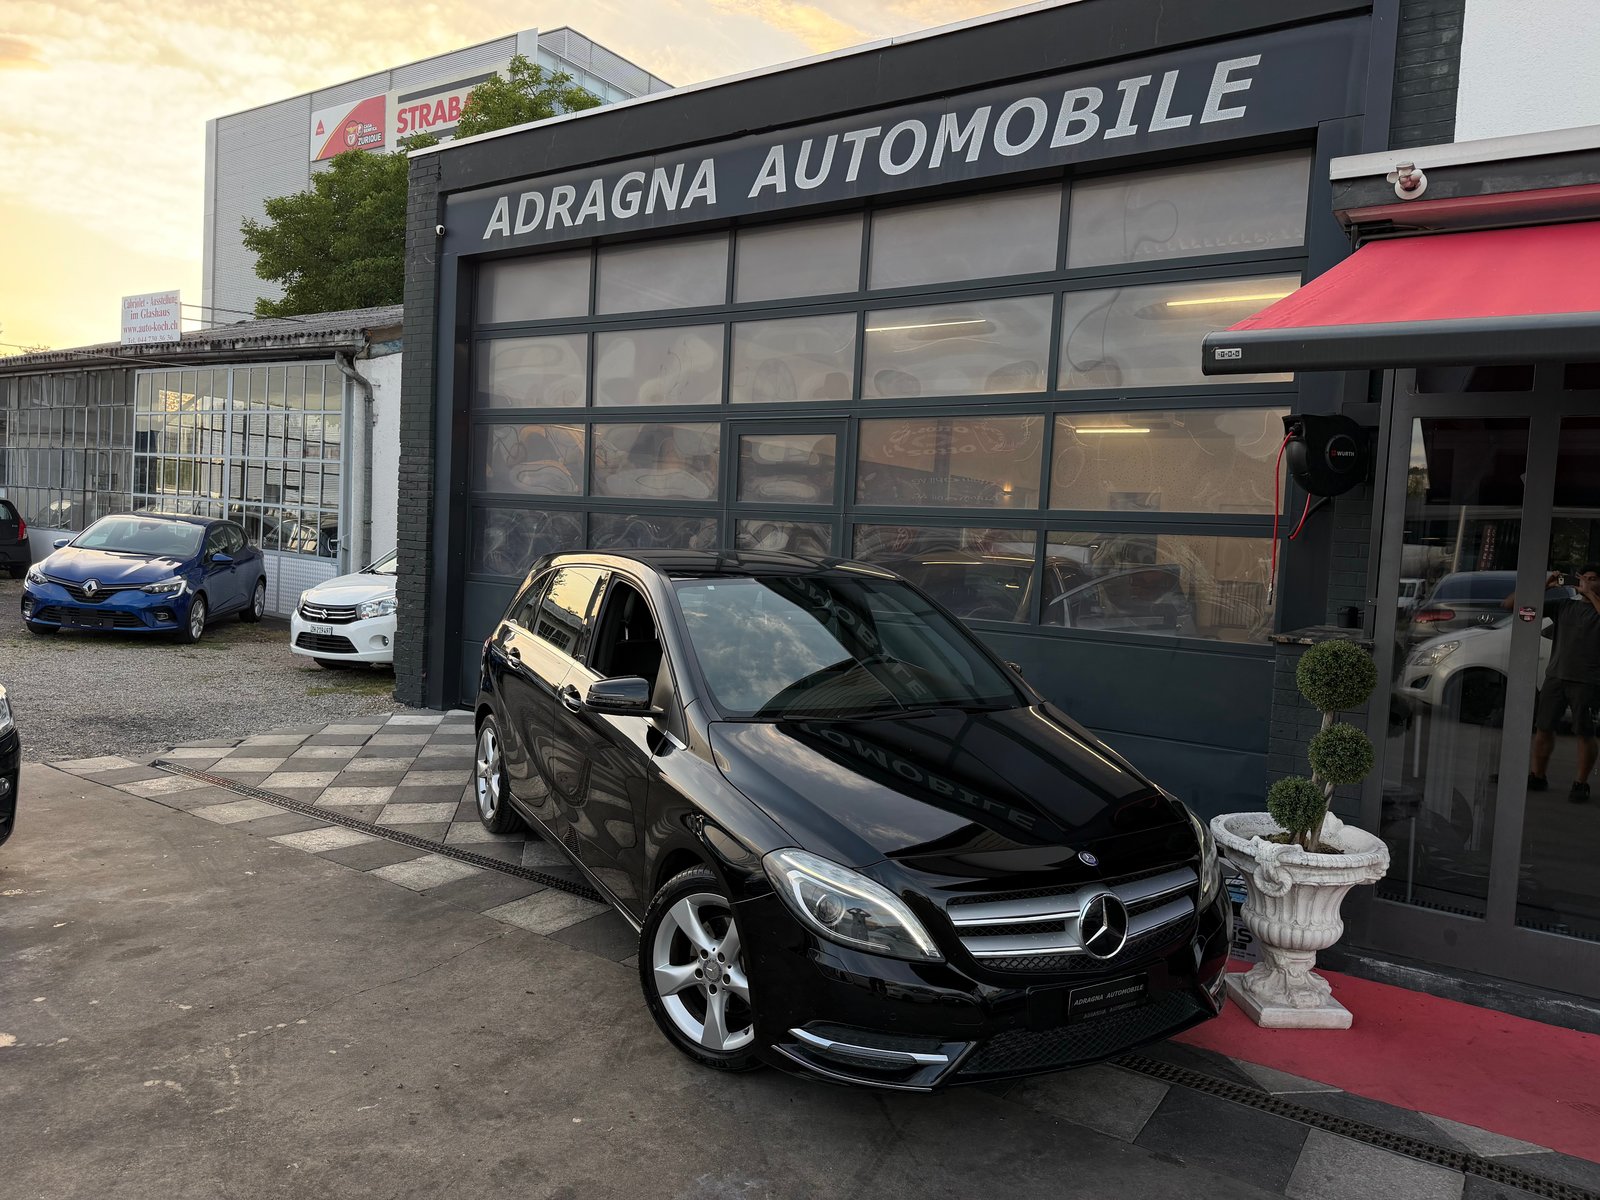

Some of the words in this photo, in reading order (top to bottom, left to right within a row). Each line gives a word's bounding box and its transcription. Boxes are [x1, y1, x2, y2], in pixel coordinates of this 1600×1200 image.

[357, 132, 382, 146] ZURIQUE
[482, 157, 717, 240] ADRAGNA
[747, 53, 1262, 199] AUTOMOBILE
[130, 310, 138, 320] im
[140, 307, 171, 319] Glashaus
[123, 319, 178, 334] www.auto-koch.ch
[1073, 994, 1104, 1006] ADRAGNA
[1105, 983, 1145, 999] AUTOMOBILE
